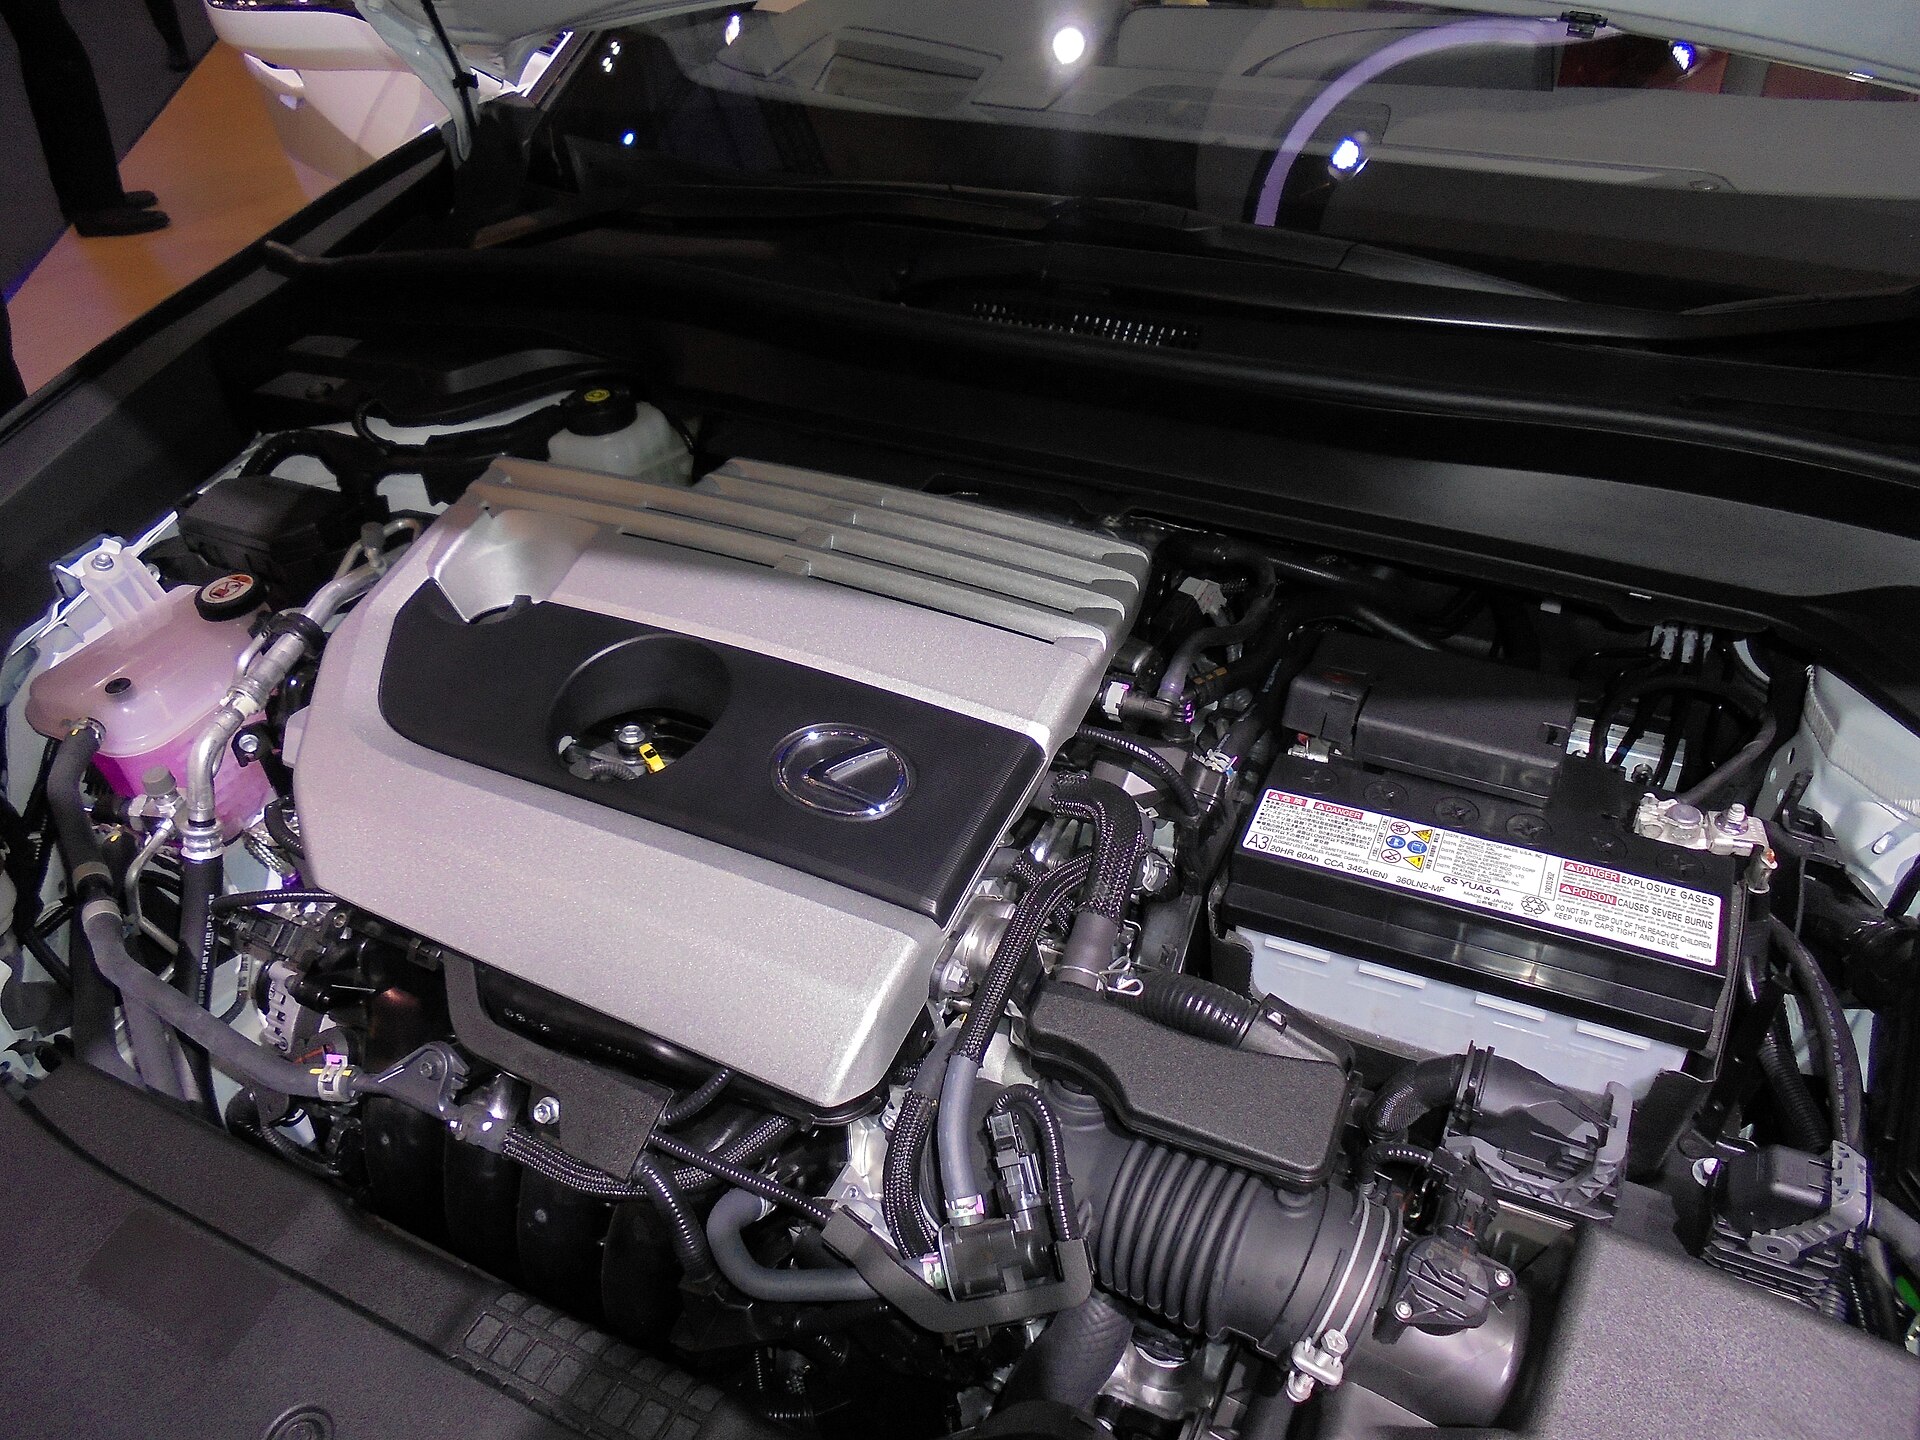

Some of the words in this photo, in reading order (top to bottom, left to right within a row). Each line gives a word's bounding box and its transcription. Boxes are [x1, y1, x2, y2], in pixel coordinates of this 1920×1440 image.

[1325, 805, 1361, 818] DANGER
[1245, 832, 1270, 850] A3
[1268, 844, 1295, 856] 20HR
[1295, 851, 1320, 863] 60Ah
[1323, 857, 1345, 868] CCA
[1346, 863, 1388, 879] 345A(EN)
[1395, 875, 1445, 894] 360LN2-MF
[1442, 875, 1458, 885] GS
[1459, 879, 1501, 896] YUASA
[1576, 864, 1618, 881] DANGER
[1621, 875, 1676, 896] EXPLOSIVE
[1680, 890, 1714, 906] GASES
[1463, 890, 1482, 898] MADE
[1491, 897, 1513, 906] JAPAN
[1571, 886, 1613, 904] POISON
[1617, 898, 1649, 913] CAUSES
[1651, 906, 1682, 921] SEVERE
[1684, 915, 1712, 929] BURNS
[1553, 911, 1572, 921] KEEP
[1574, 916, 1592, 926] VENT
[1594, 921, 1614, 932] CAPS
[1616, 926, 1636, 938] TIGHT
[1638, 932, 1655, 942] AND
[1656, 937, 1679, 949] LEVEL
[1555, 903, 1565, 911] DO
[1565, 906, 1579, 915] NOT
[1579, 909, 1589, 918] TIP
[1593, 913, 1609, 923] KEEP
[1610, 917, 1623, 926] OUT
[1624, 920, 1633, 929] OF
[1634, 923, 1646, 932] THE
[1647, 926, 1669, 938] REACH
[1670, 932, 1679, 941] OF
[1679, 934, 1711, 949] CHILDREN
